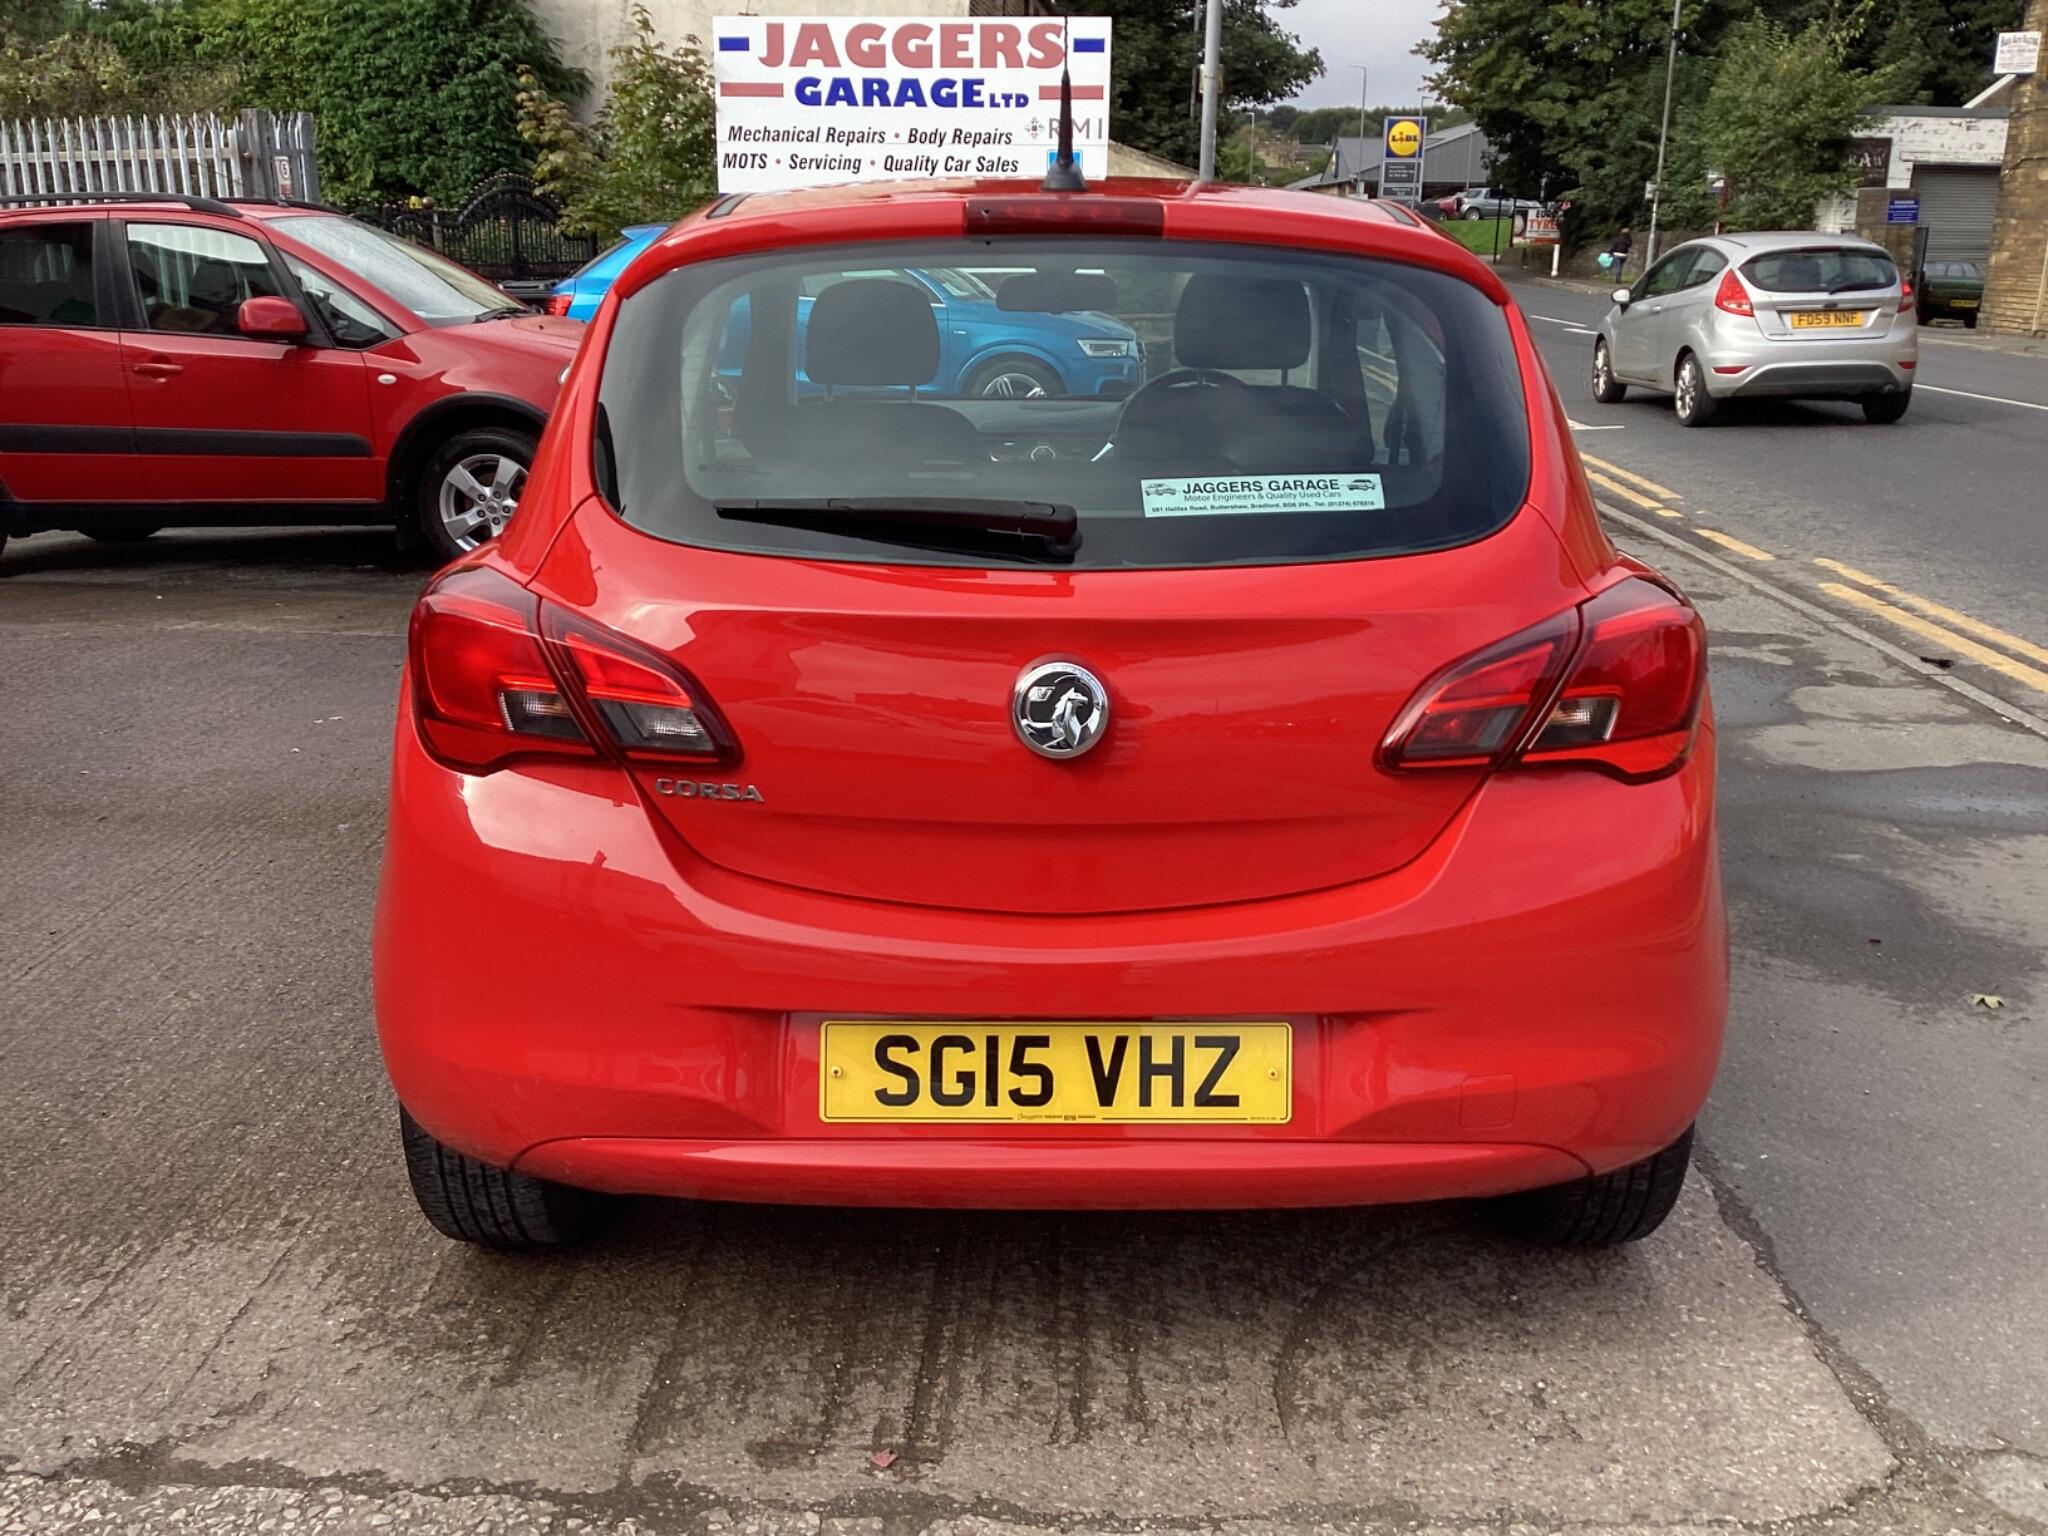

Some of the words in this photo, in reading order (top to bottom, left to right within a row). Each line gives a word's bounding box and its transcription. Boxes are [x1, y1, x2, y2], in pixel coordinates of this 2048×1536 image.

[758, 23, 1065, 69] JAGGERS
[795, 77, 985, 108] GARAGE
[989, 93, 1029, 108] LTD
[728, 125, 820, 144] Mechanical
[826, 127, 886, 147] Repairs
[908, 128, 946, 147] Body
[952, 128, 1013, 147] Repairs
[723, 153, 768, 169] MOTS
[789, 154, 862, 173] Servicing
[884, 156, 938, 176] Quality
[944, 157, 971, 173] Car
[976, 156, 1019, 173] Sales
[1834, 311, 1857, 324] NNF
[1183, 481, 1263, 493] JAGGERS
[1268, 479, 1340, 491] GARAGE
[1184, 493, 1210, 502] Motor
[1212, 491, 1255, 502] Engineers
[1266, 491, 1297, 500] Quality
[1299, 490, 1320, 499] Used
[1323, 490, 1341, 498] Cars
[656, 778, 764, 802] CORSA
[874, 1034, 1054, 1107] SG15
[1084, 1034, 1241, 1107] VHZ
